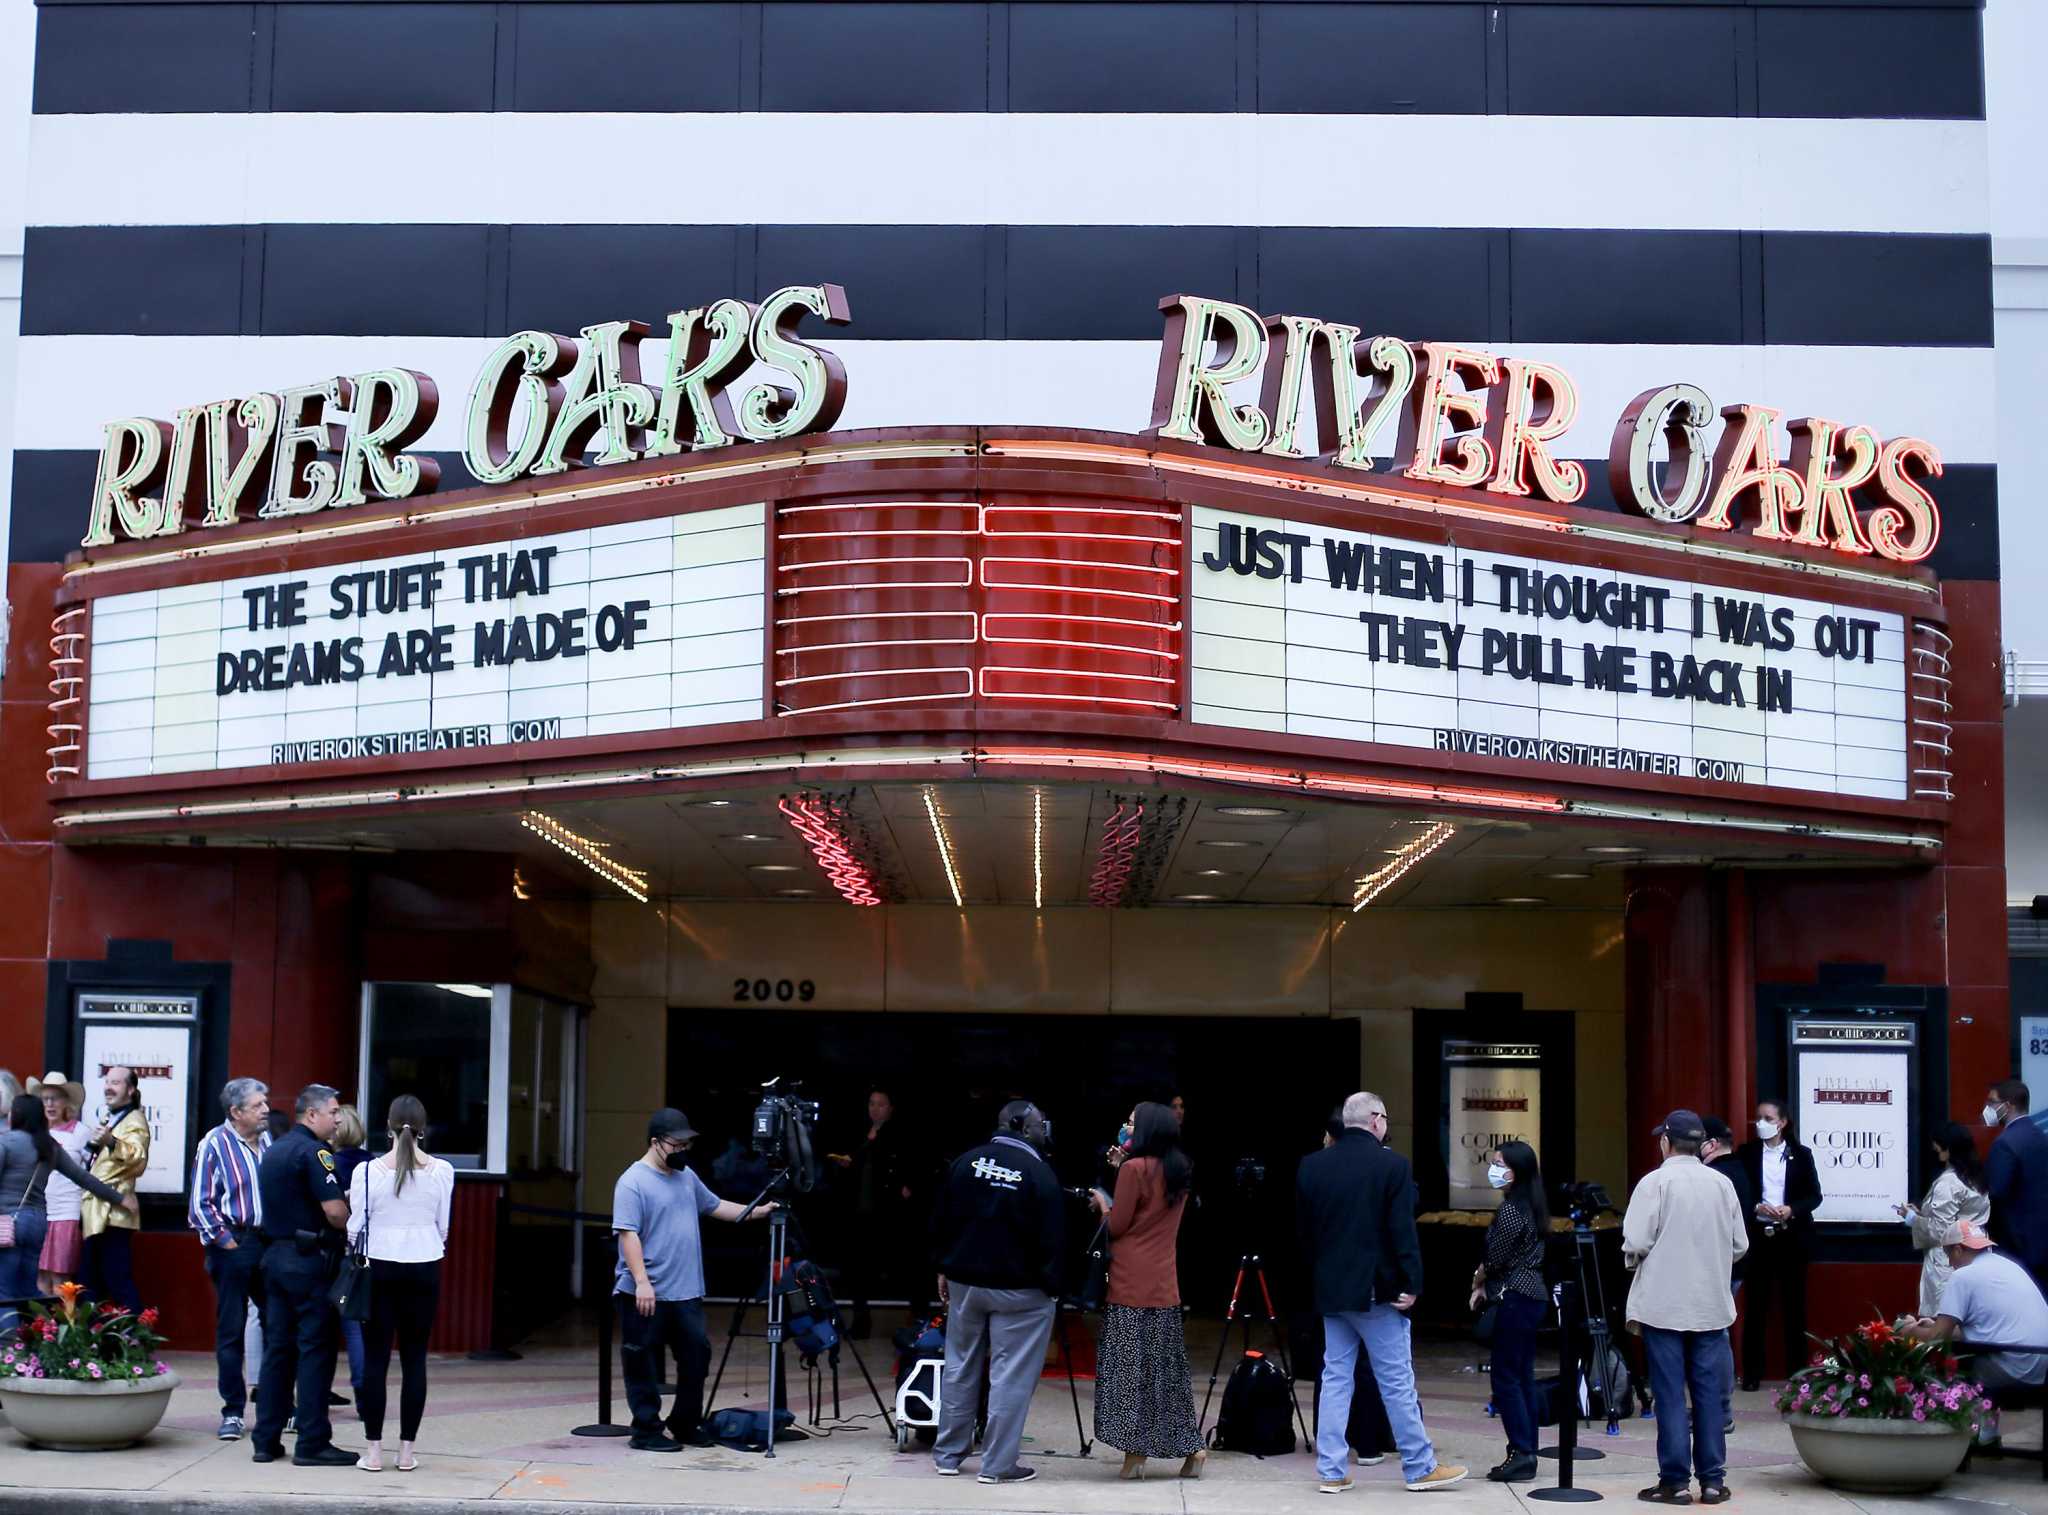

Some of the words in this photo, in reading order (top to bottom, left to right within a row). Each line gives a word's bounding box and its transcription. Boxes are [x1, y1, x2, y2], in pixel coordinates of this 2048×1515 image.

[81, 366, 436, 547] RIVER
[462, 284, 850, 484] OAKS
[1154, 294, 1588, 503] RIVER
[1609, 383, 1943, 562] OAKS
[242, 581, 308, 632] THE
[329, 561, 445, 620] STUFF
[458, 546, 558, 604] THAT
[1203, 522, 1310, 583] JUST
[1323, 538, 1444, 603] WHEN
[1463, 559, 1474, 607] I
[1492, 564, 1670, 634] THOUGHT
[1692, 592, 1703, 638] I
[1714, 596, 1795, 652] WAS
[1814, 614, 1881, 665] OUT
[216, 636, 364, 697] DREAMS
[377, 625, 456, 678] ARE
[474, 608, 587, 668] MADE
[595, 600, 651, 653] OF
[1359, 611, 1466, 672] THEY
[1482, 628, 1573, 687] PULL
[1583, 643, 1638, 694] ME
[1651, 651, 1747, 709] BACK
[1756, 666, 1793, 714] IN
[271, 725, 491, 764] RIVEROKSTHEATER
[510, 718, 560, 743] COM
[1434, 729, 1680, 775] RIVEROAKSTHEATER
[1695, 758, 1744, 783] COM
[733, 978, 816, 1001] 2009
[1826, 1093, 1882, 1101] THEATER
[1813, 1131, 1895, 1149] COMING
[1824, 1151, 1884, 1169] SOON
